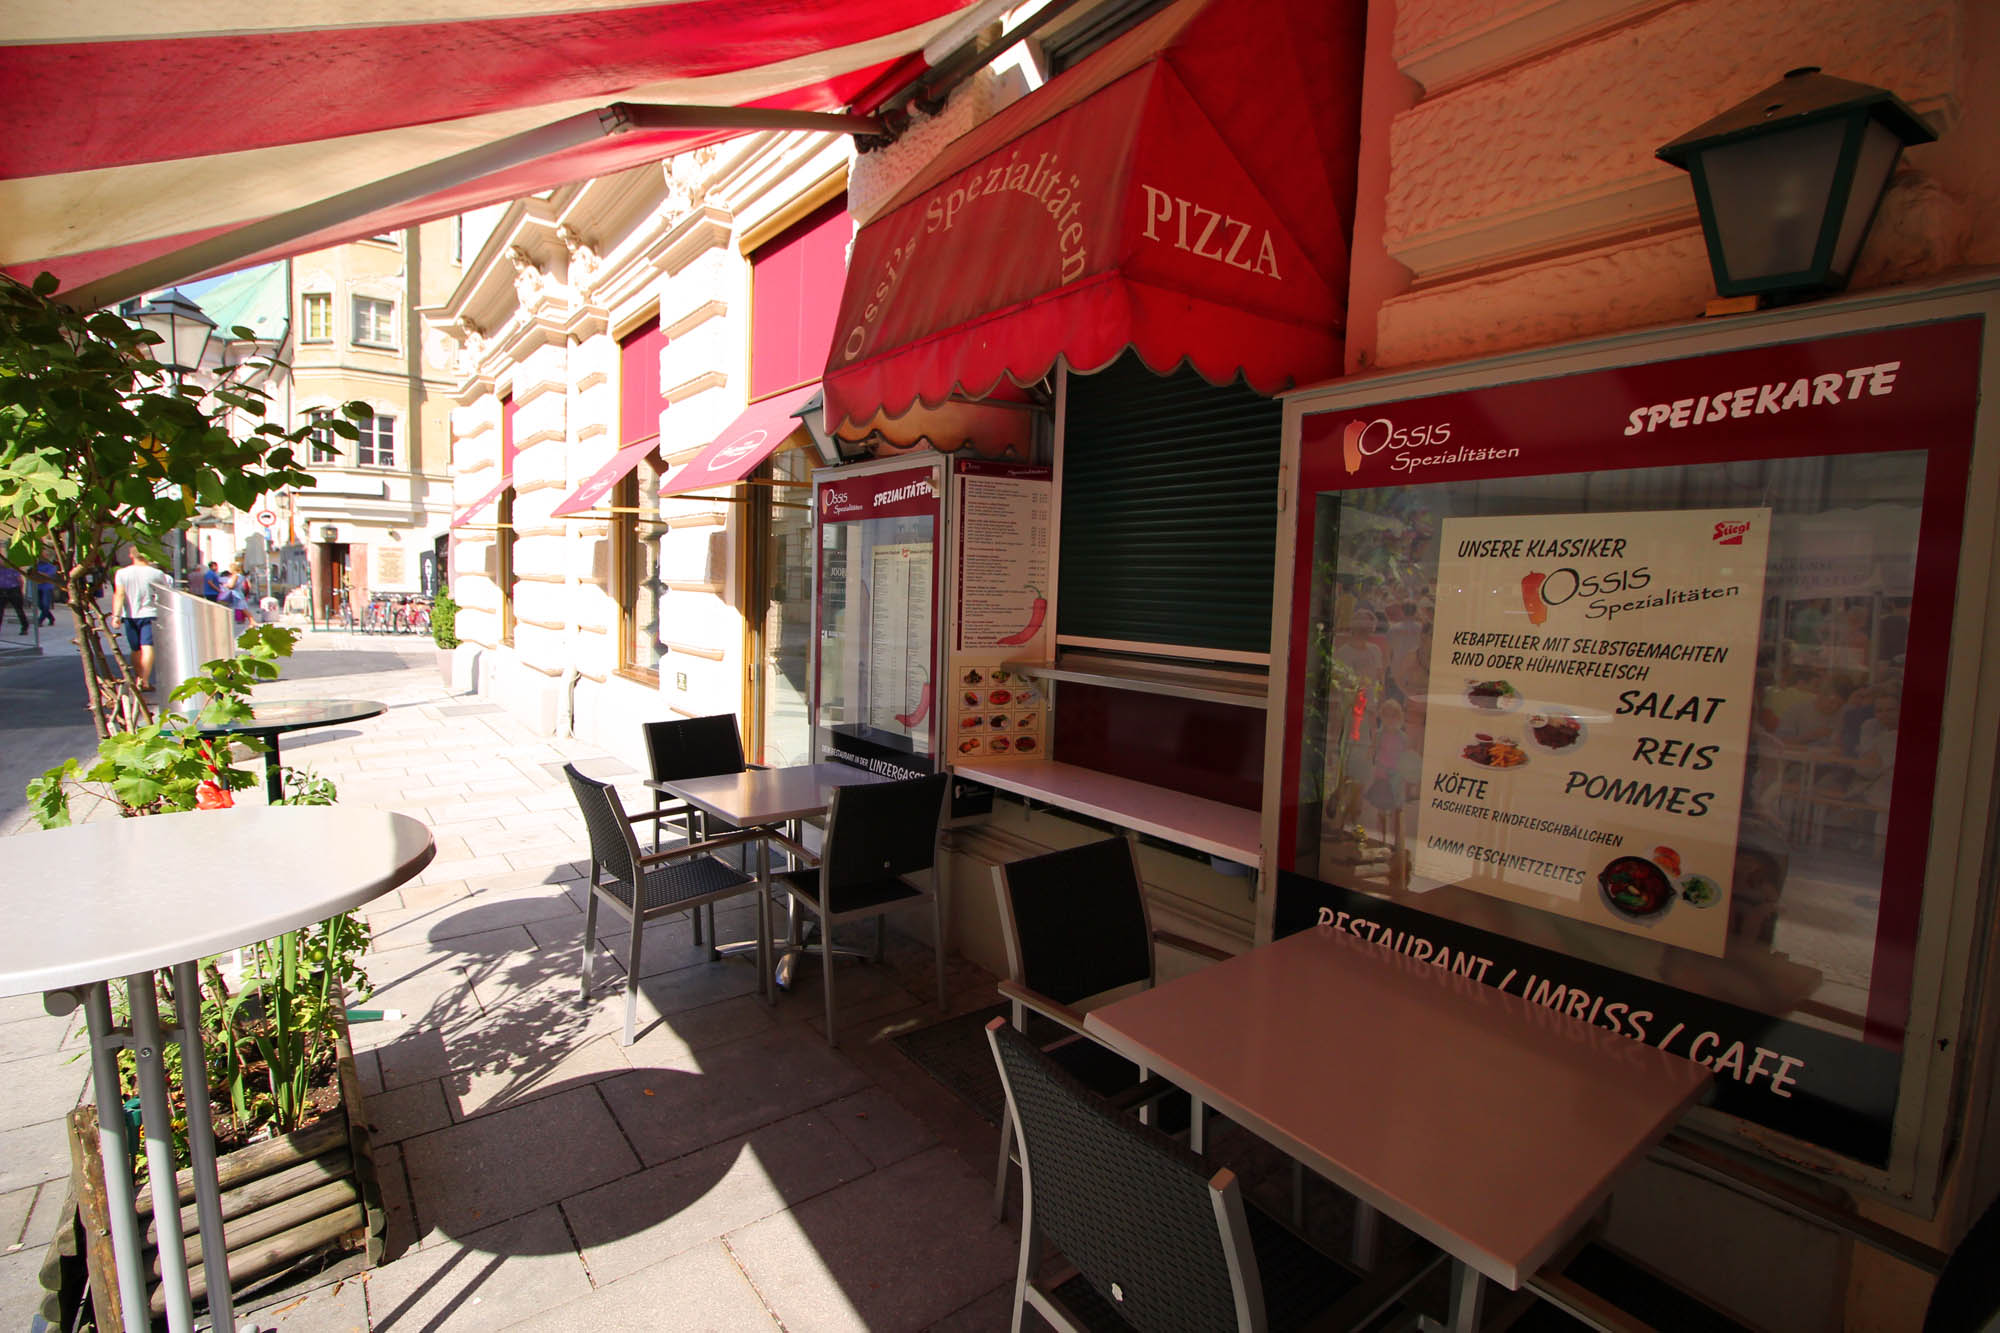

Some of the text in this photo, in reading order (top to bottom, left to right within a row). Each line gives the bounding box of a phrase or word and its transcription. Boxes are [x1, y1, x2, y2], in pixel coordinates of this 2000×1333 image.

[1141, 184, 1282, 280] PIZZA
[844, 150, 1087, 361] Ossi's Spezialitäten
[1625, 361, 1901, 436] SPEISEKARTE
[1390, 446, 1520, 474] Spezialitäten
[1712, 520, 1750, 541] Stiegl
[1458, 538, 1626, 559] UNSERE KLASSIKER
[1585, 585, 1740, 621] Spezialitäten
[1452, 631, 1728, 664] KEBAPTELLER MIT SELBSTGEMACHTEN
[1451, 652, 1651, 681] RIND ODER HÜHNERFLEISCH
[1616, 690, 1726, 724] SALAT
[1632, 737, 1720, 770] REIS
[1433, 772, 1489, 800] KÖFTE
[1564, 771, 1715, 817] POMMES
[1432, 798, 1624, 848] FASCHIERTE RINDFLEISCHBÄLLCHEN
[1427, 835, 1587, 886] LAMM GESCHNETZELTES
[1523, 974, 1654, 1043] IMBISS
[1689, 1031, 1804, 1098] CAFE
